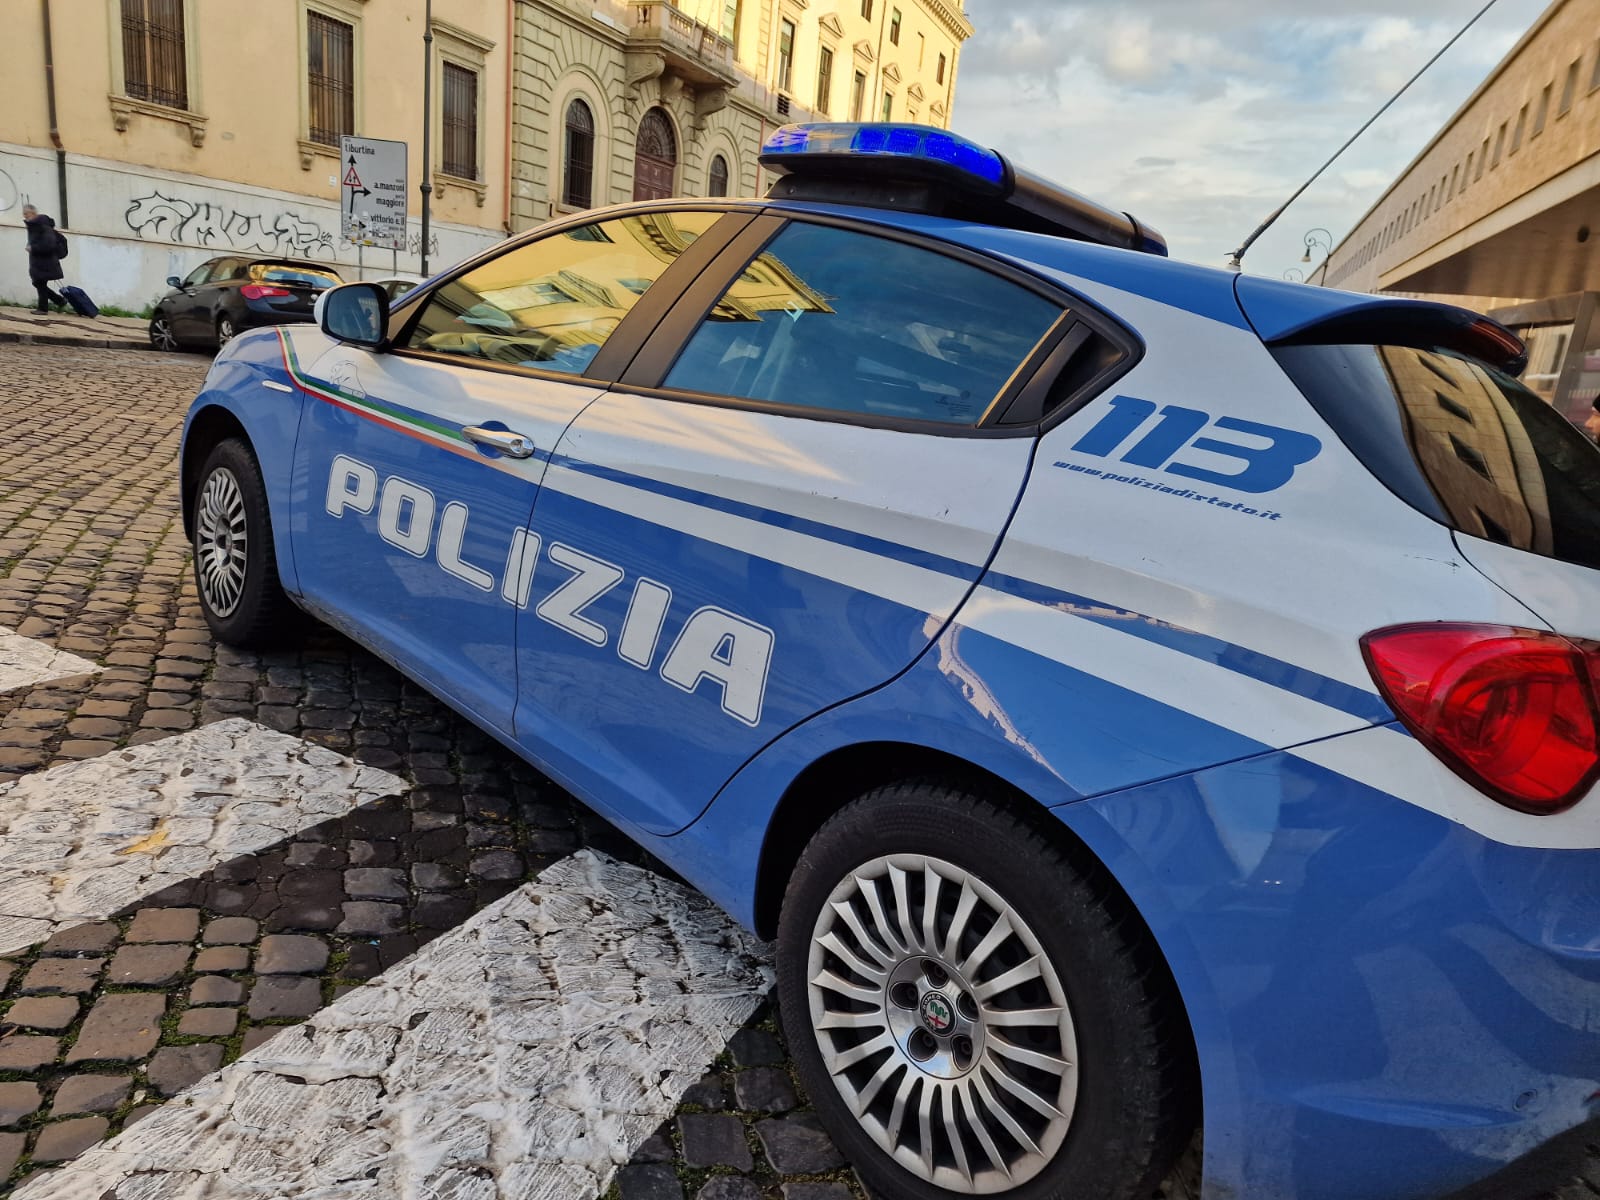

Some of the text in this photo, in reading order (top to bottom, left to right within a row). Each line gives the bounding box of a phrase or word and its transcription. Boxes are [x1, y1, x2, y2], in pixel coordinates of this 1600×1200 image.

[345, 143, 375, 155] tiburtina
[370, 213, 394, 224] vittorio
[376, 197, 405, 208] maggiore
[1070, 394, 1322, 493] 113
[1052, 460, 1283, 521] www.poliziadistato.it
[325, 453, 775, 727] POLIZIA
